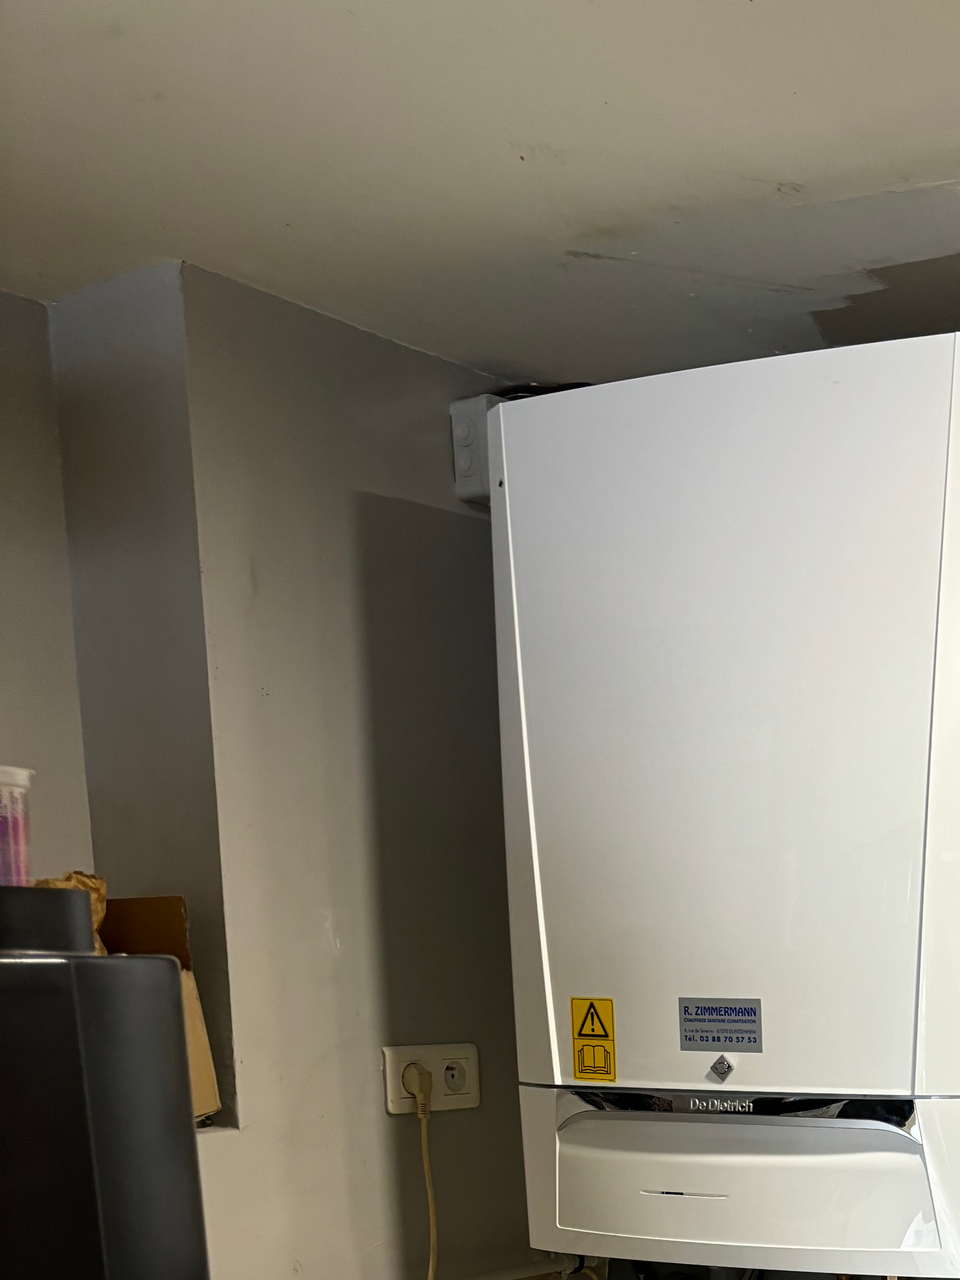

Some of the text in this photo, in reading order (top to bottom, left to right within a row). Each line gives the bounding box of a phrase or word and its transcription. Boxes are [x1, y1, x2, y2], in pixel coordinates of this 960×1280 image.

[684, 1006, 756, 1017] R. ZIMMERMANN
[690, 1098, 754, 1112] De Dietrich
